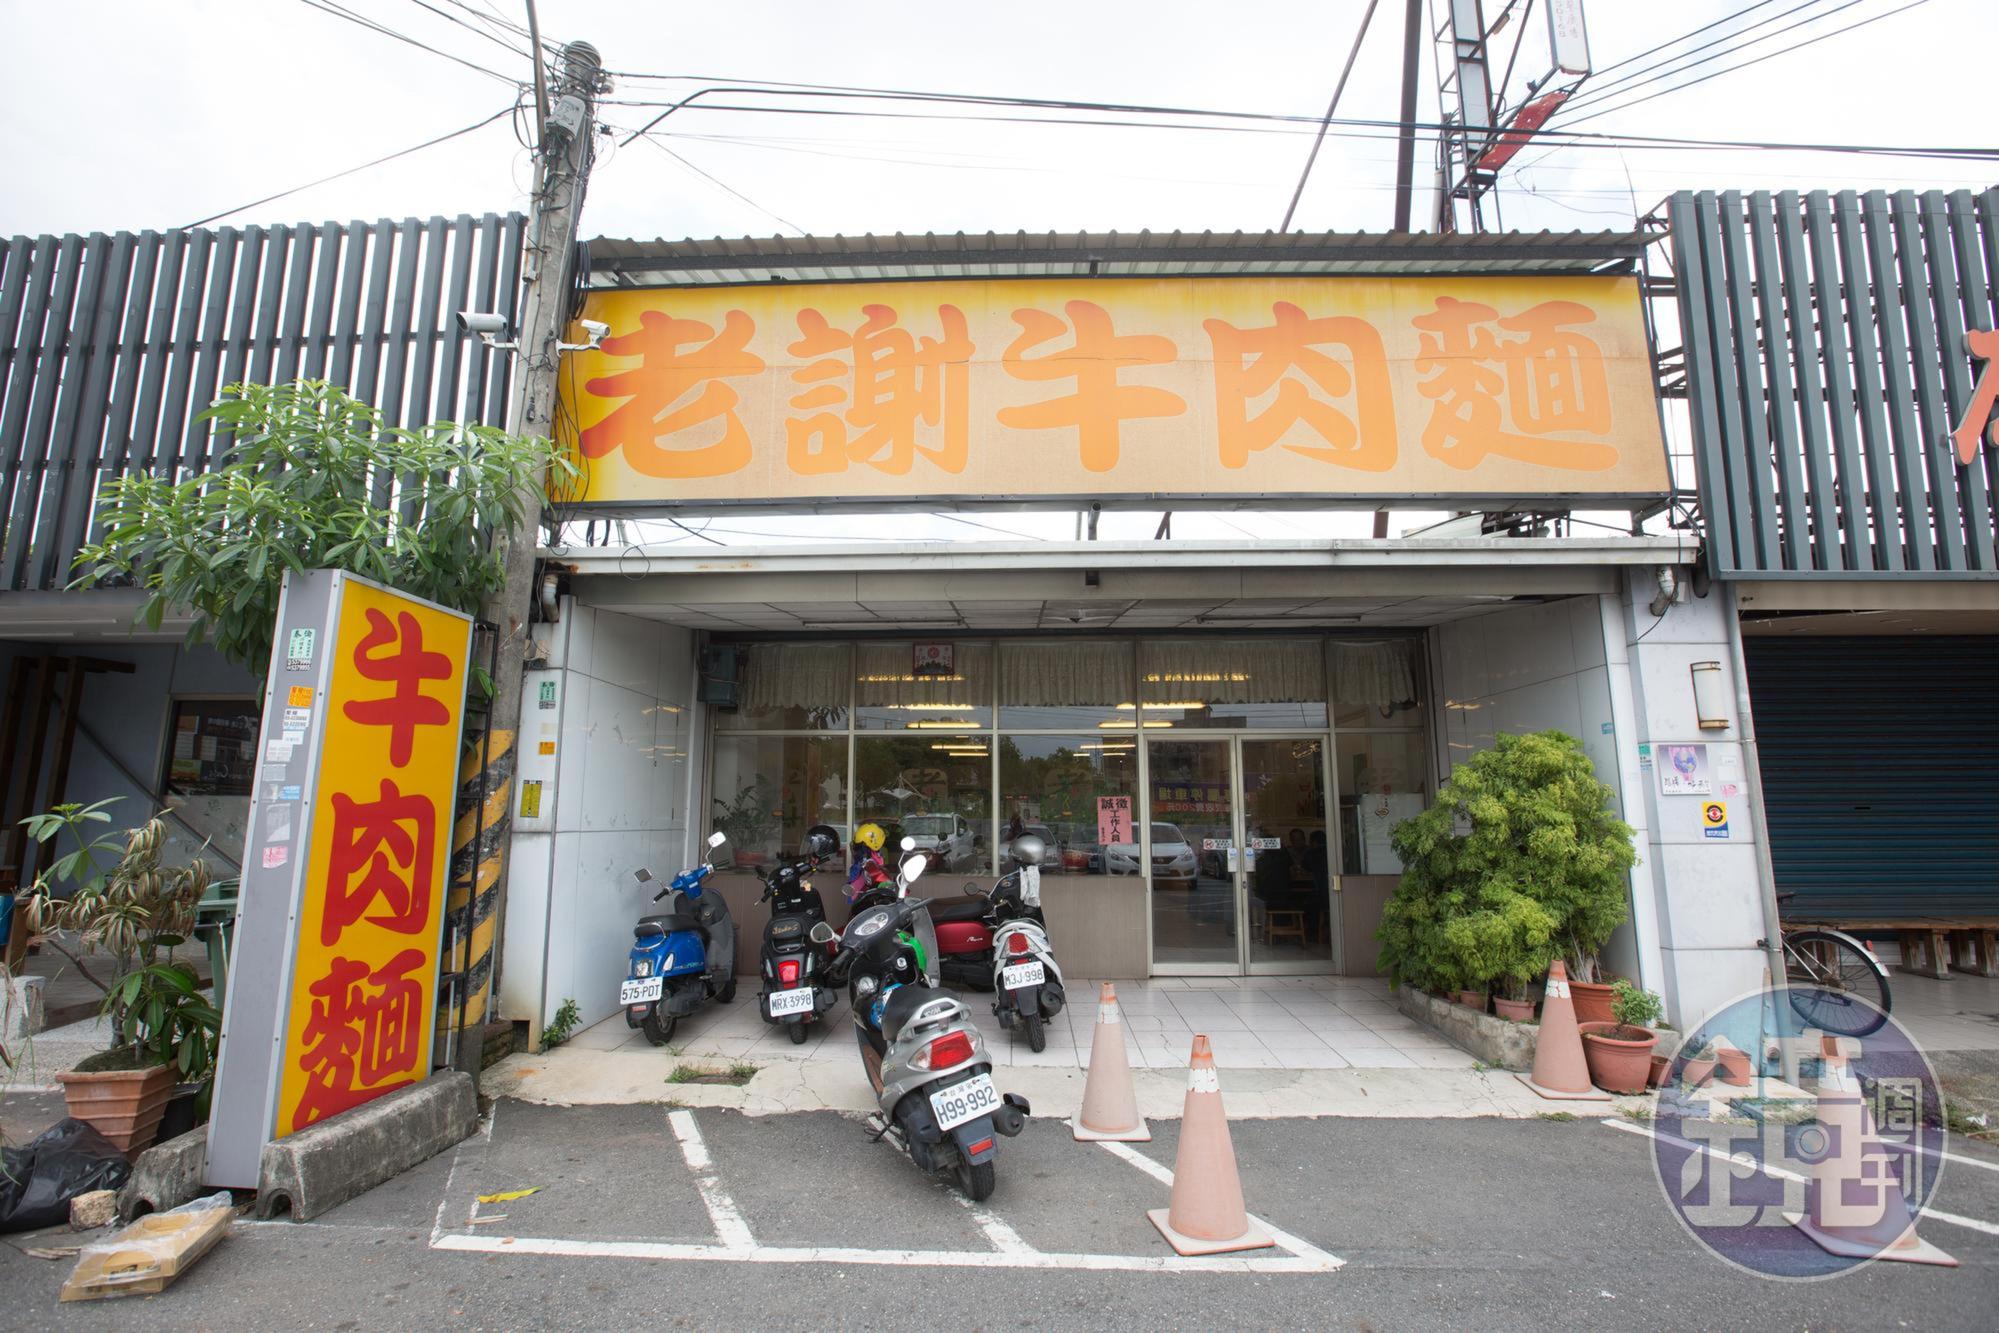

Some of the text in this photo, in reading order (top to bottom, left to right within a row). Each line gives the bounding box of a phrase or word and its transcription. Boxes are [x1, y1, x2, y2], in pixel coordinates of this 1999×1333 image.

[580, 295, 1620, 479] 老謝牛肉麵
[1110, 810, 1120, 843] 工作人員
[292, 607, 453, 1133] 牛肉麵
[621, 983, 661, 1001] 575-PDT
[771, 993, 812, 1012] MRX-3998
[935, 1086, 998, 1125] H99-992
